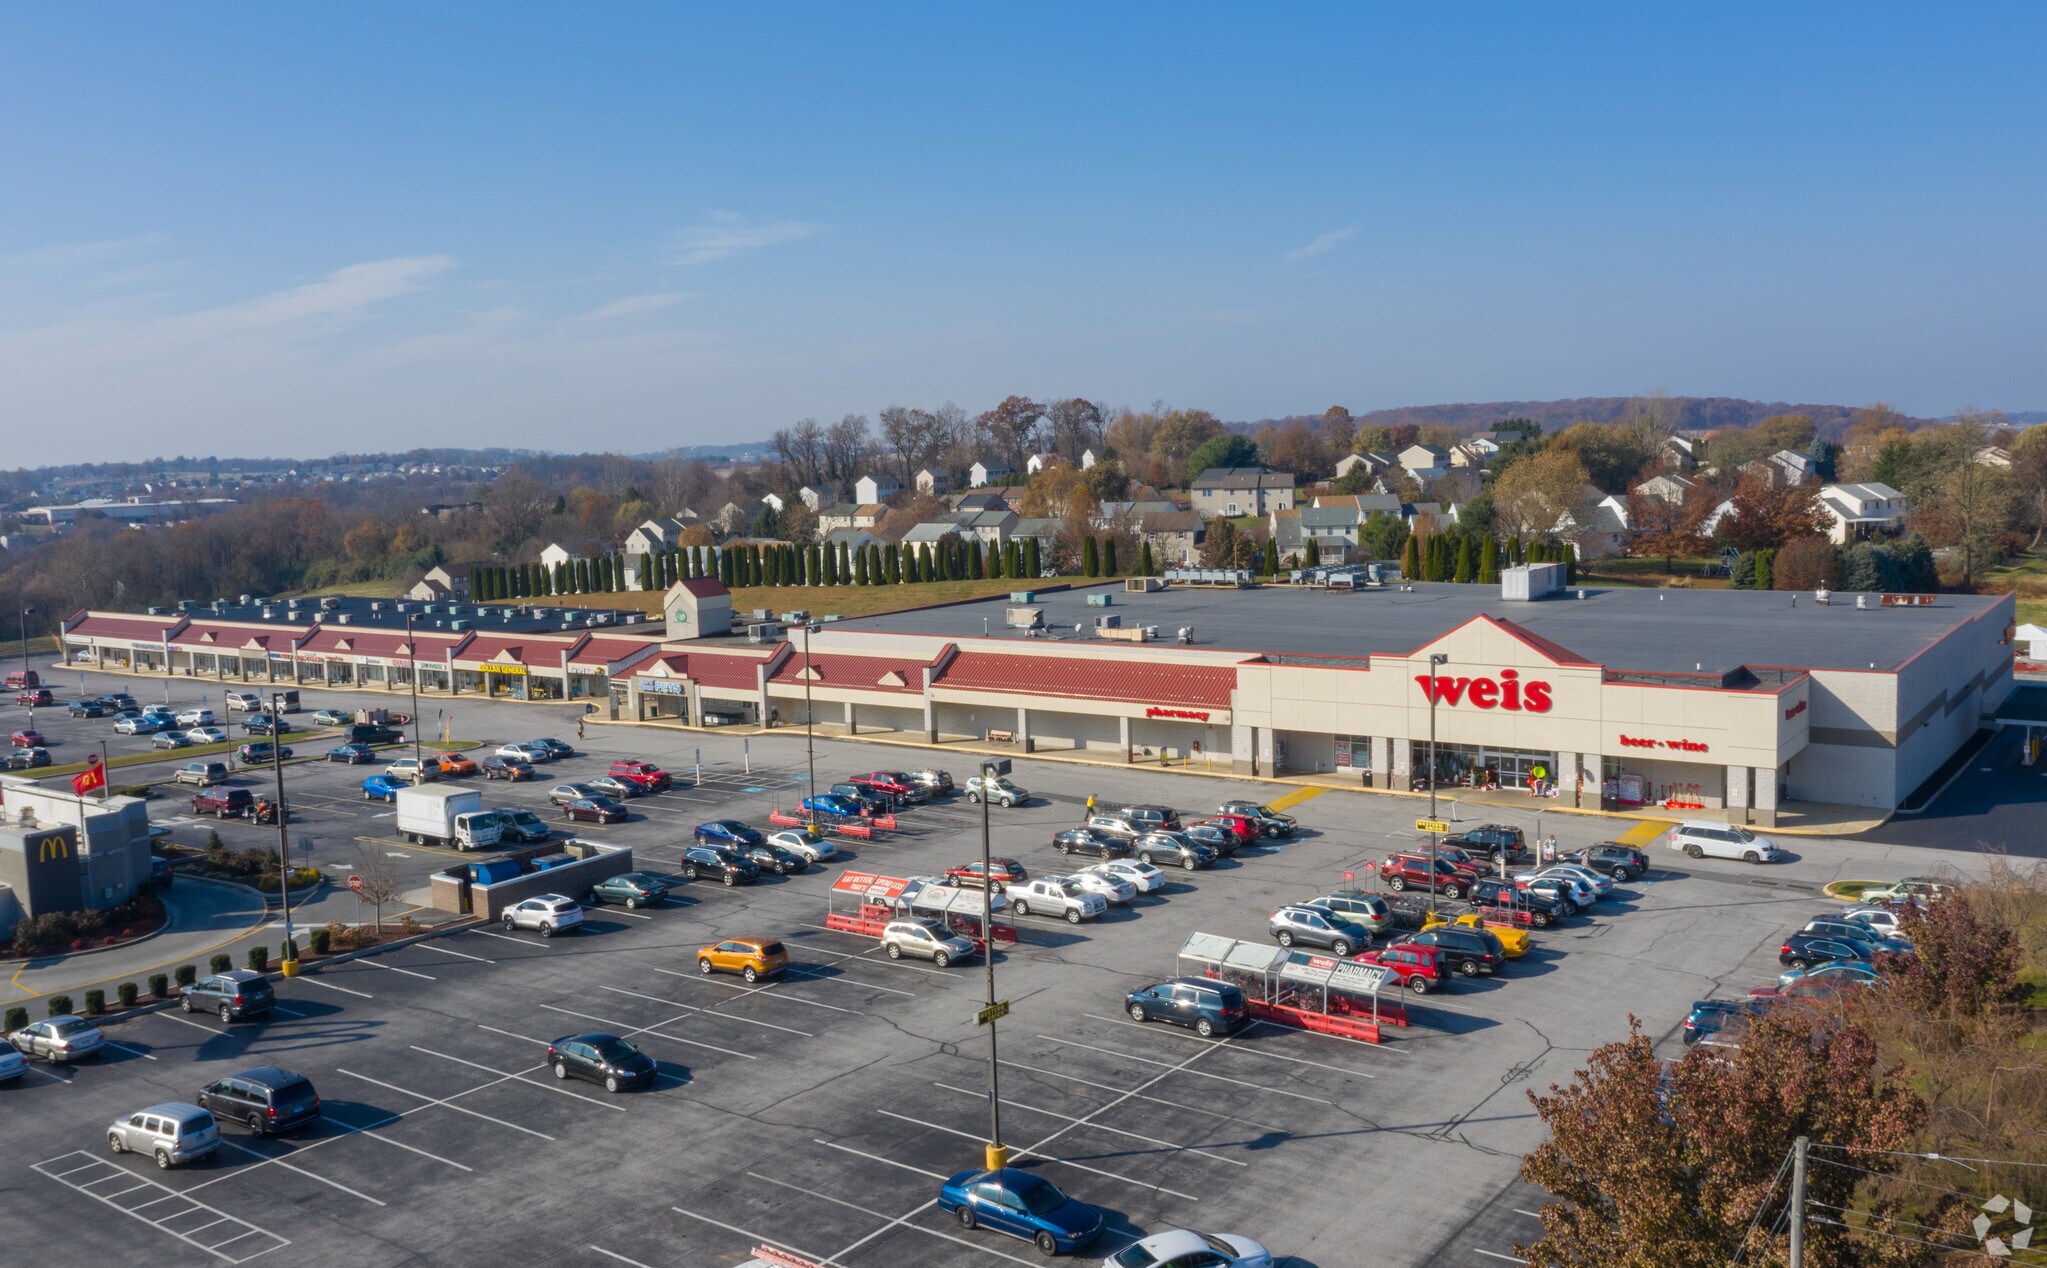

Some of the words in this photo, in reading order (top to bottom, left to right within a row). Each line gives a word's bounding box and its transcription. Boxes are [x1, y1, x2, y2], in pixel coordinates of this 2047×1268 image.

[501, 666, 526, 675] GENERAL
[654, 681, 682, 694] PETS
[1415, 669, 1552, 712] weis
[1146, 706, 1210, 722] pharmacy
[1619, 734, 1656, 749] beer
[1665, 738, 1709, 753] wine
[875, 878, 893, 886] SPEND
[1312, 958, 1334, 967] weis
[1336, 963, 1383, 980] PHARMACY
